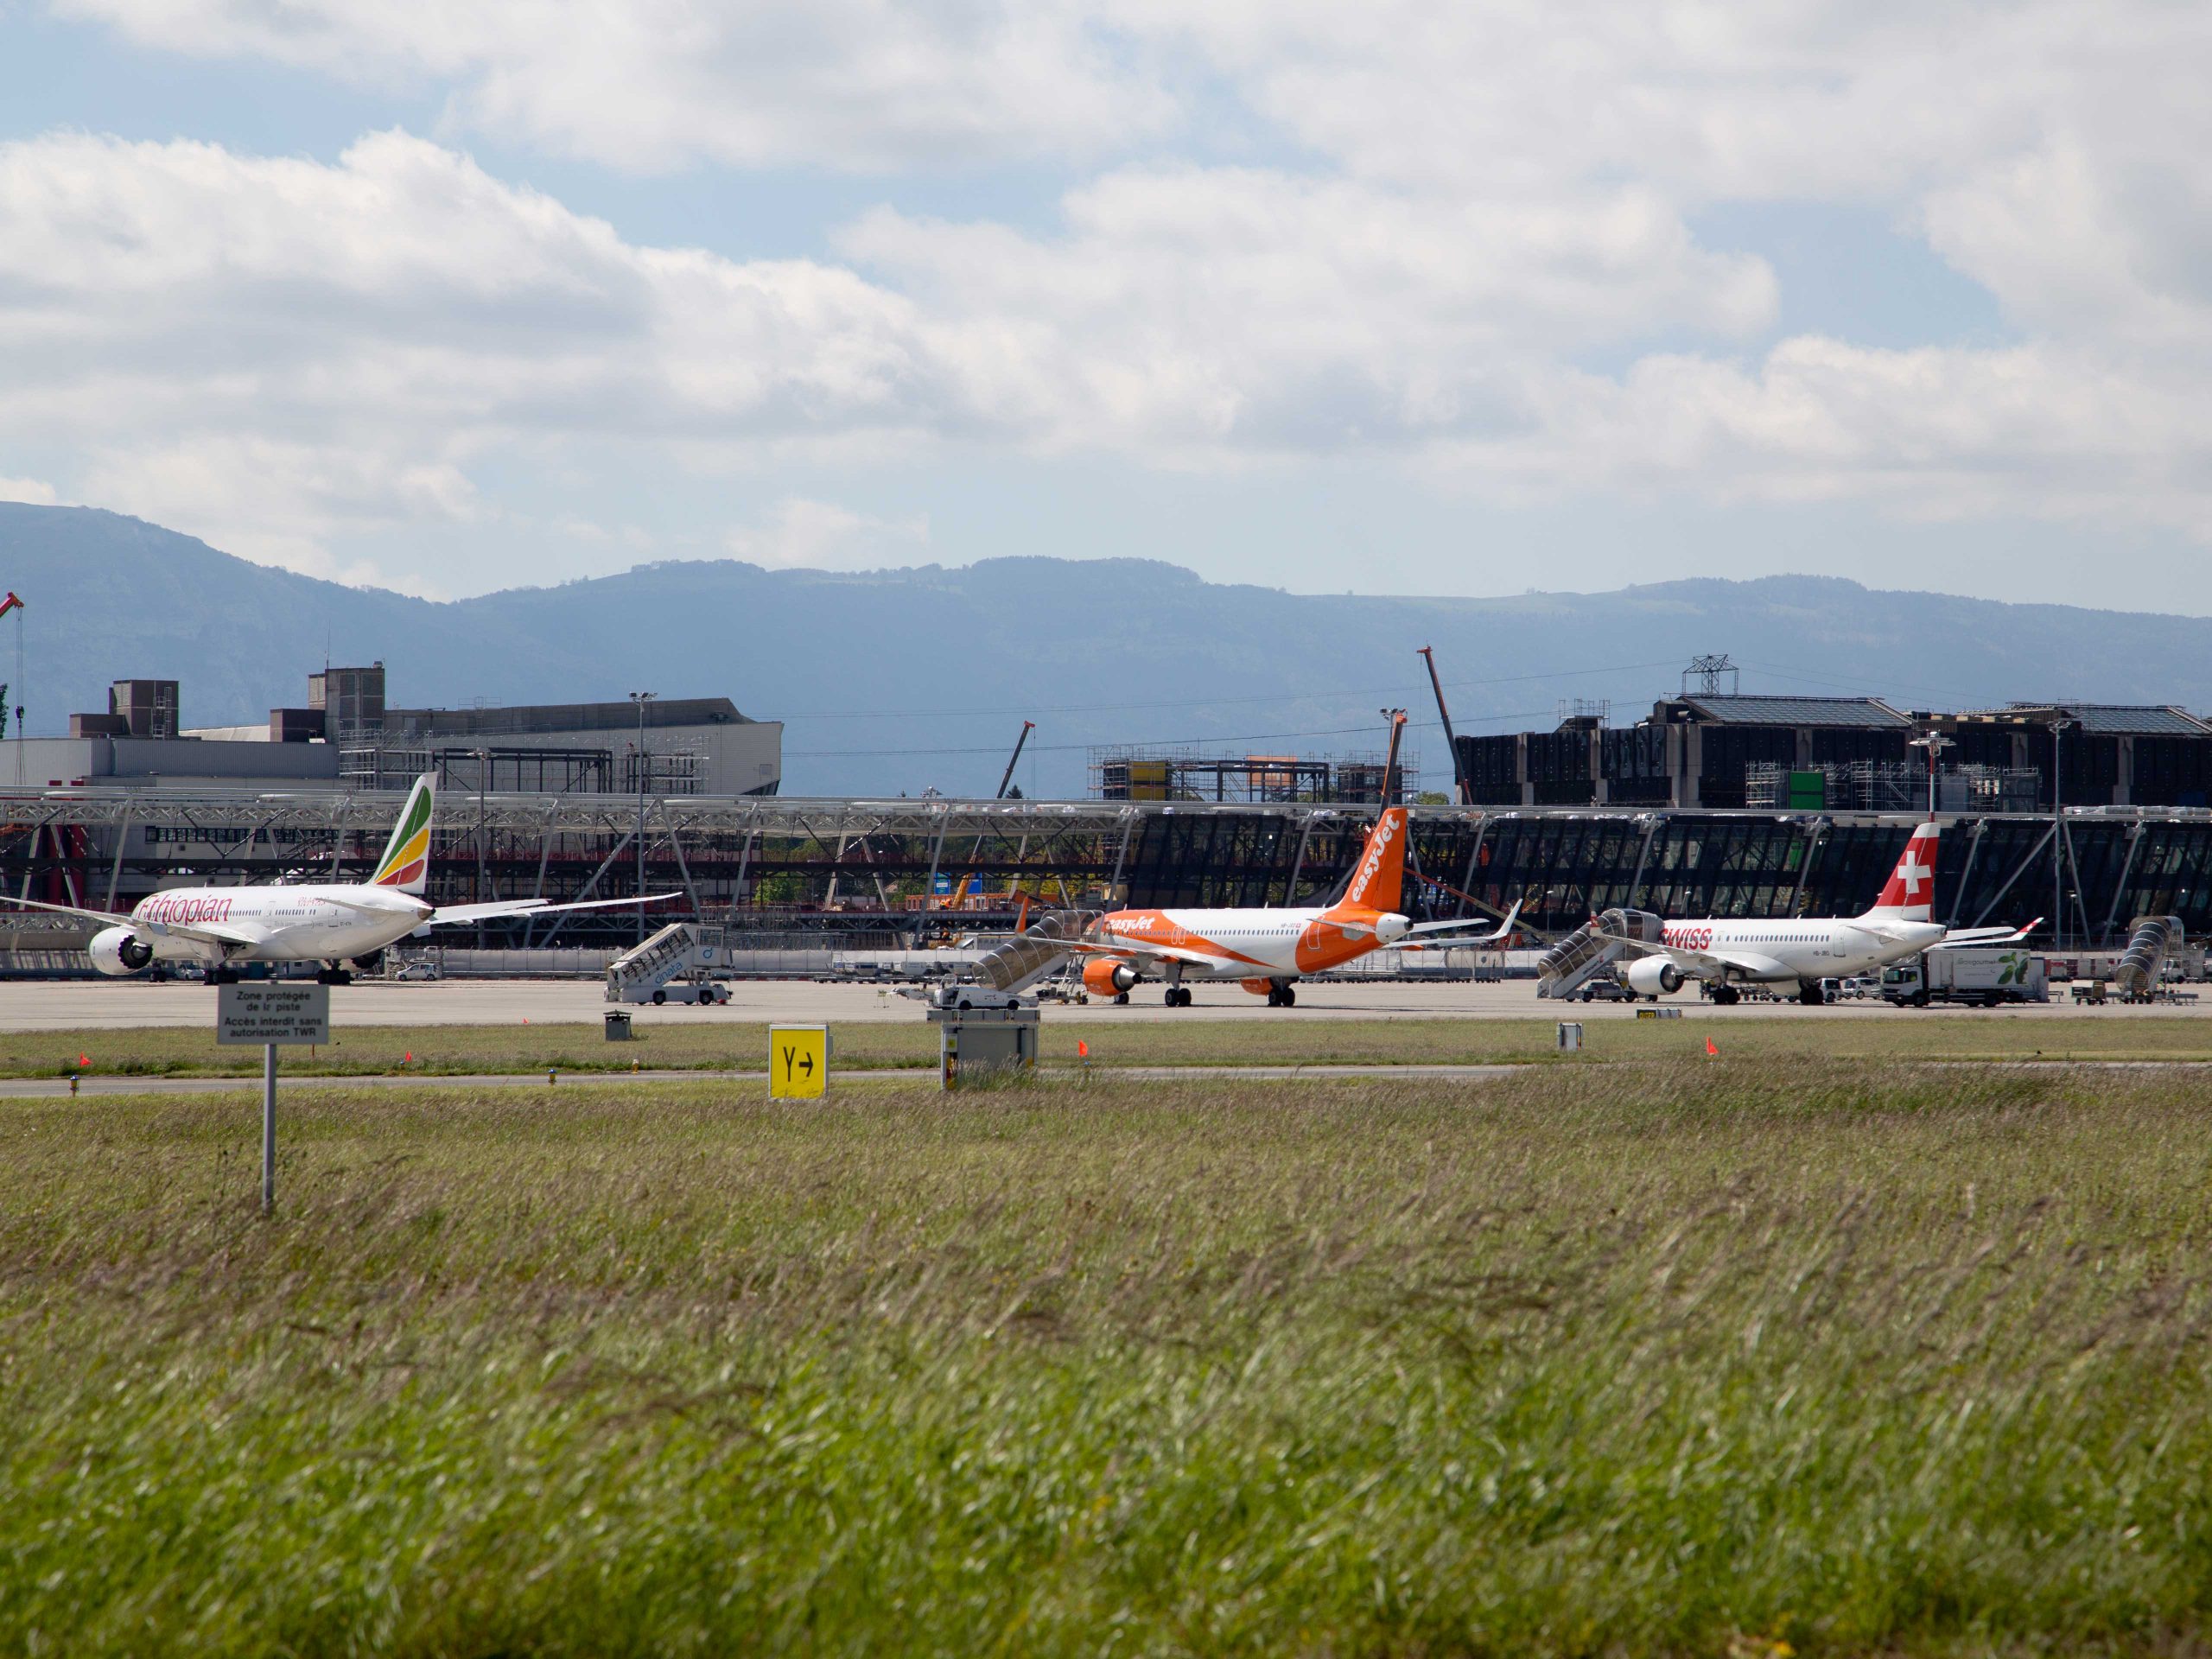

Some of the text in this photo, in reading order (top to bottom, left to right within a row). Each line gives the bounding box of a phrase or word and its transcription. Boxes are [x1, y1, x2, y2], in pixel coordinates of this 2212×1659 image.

[1352, 814, 1400, 903] easyJet
[137, 893, 232, 926] Ethiopian
[655, 961, 683, 984] dnata
[236, 990, 310, 1002] Zone protégée
[246, 1003, 258, 1012] de
[276, 1002, 301, 1014] piste
[225, 1017, 256, 1027] Accès
[260, 1016, 295, 1027] interdit
[230, 1027, 316, 1037] autorisation TWR
[783, 1046, 796, 1083] Y
